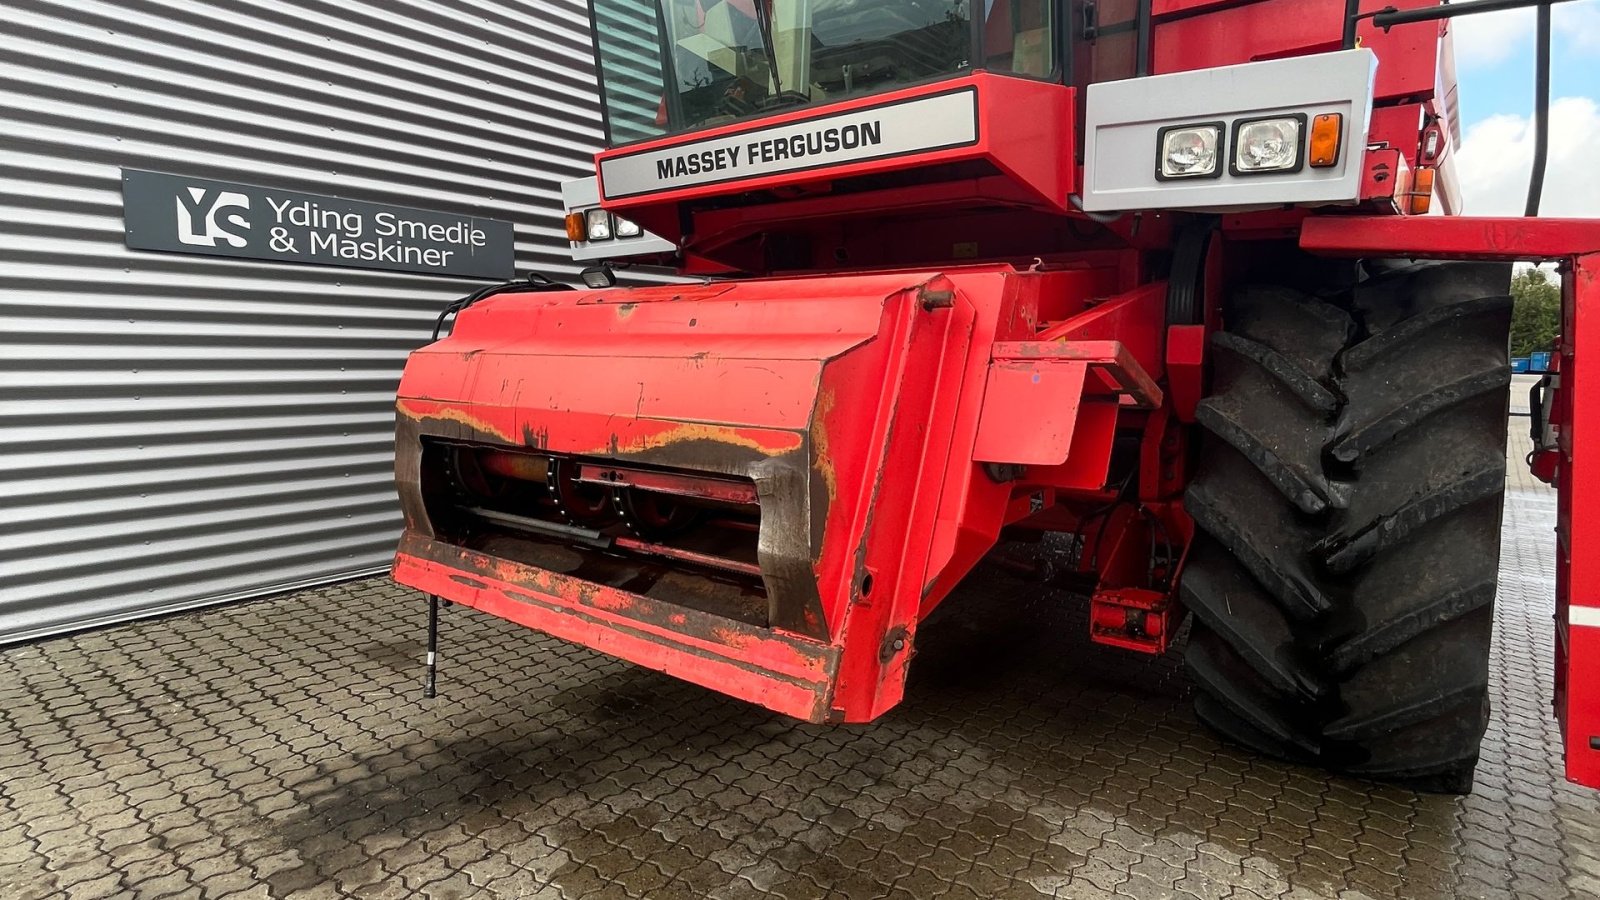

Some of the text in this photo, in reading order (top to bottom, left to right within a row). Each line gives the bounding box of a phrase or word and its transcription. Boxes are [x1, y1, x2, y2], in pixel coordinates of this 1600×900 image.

[656, 120, 882, 180] MASSEY FERGUSON
[176, 186, 251, 248] YS
[265, 196, 486, 247] Yding Smedie
[269, 226, 455, 267] & Maskiner
